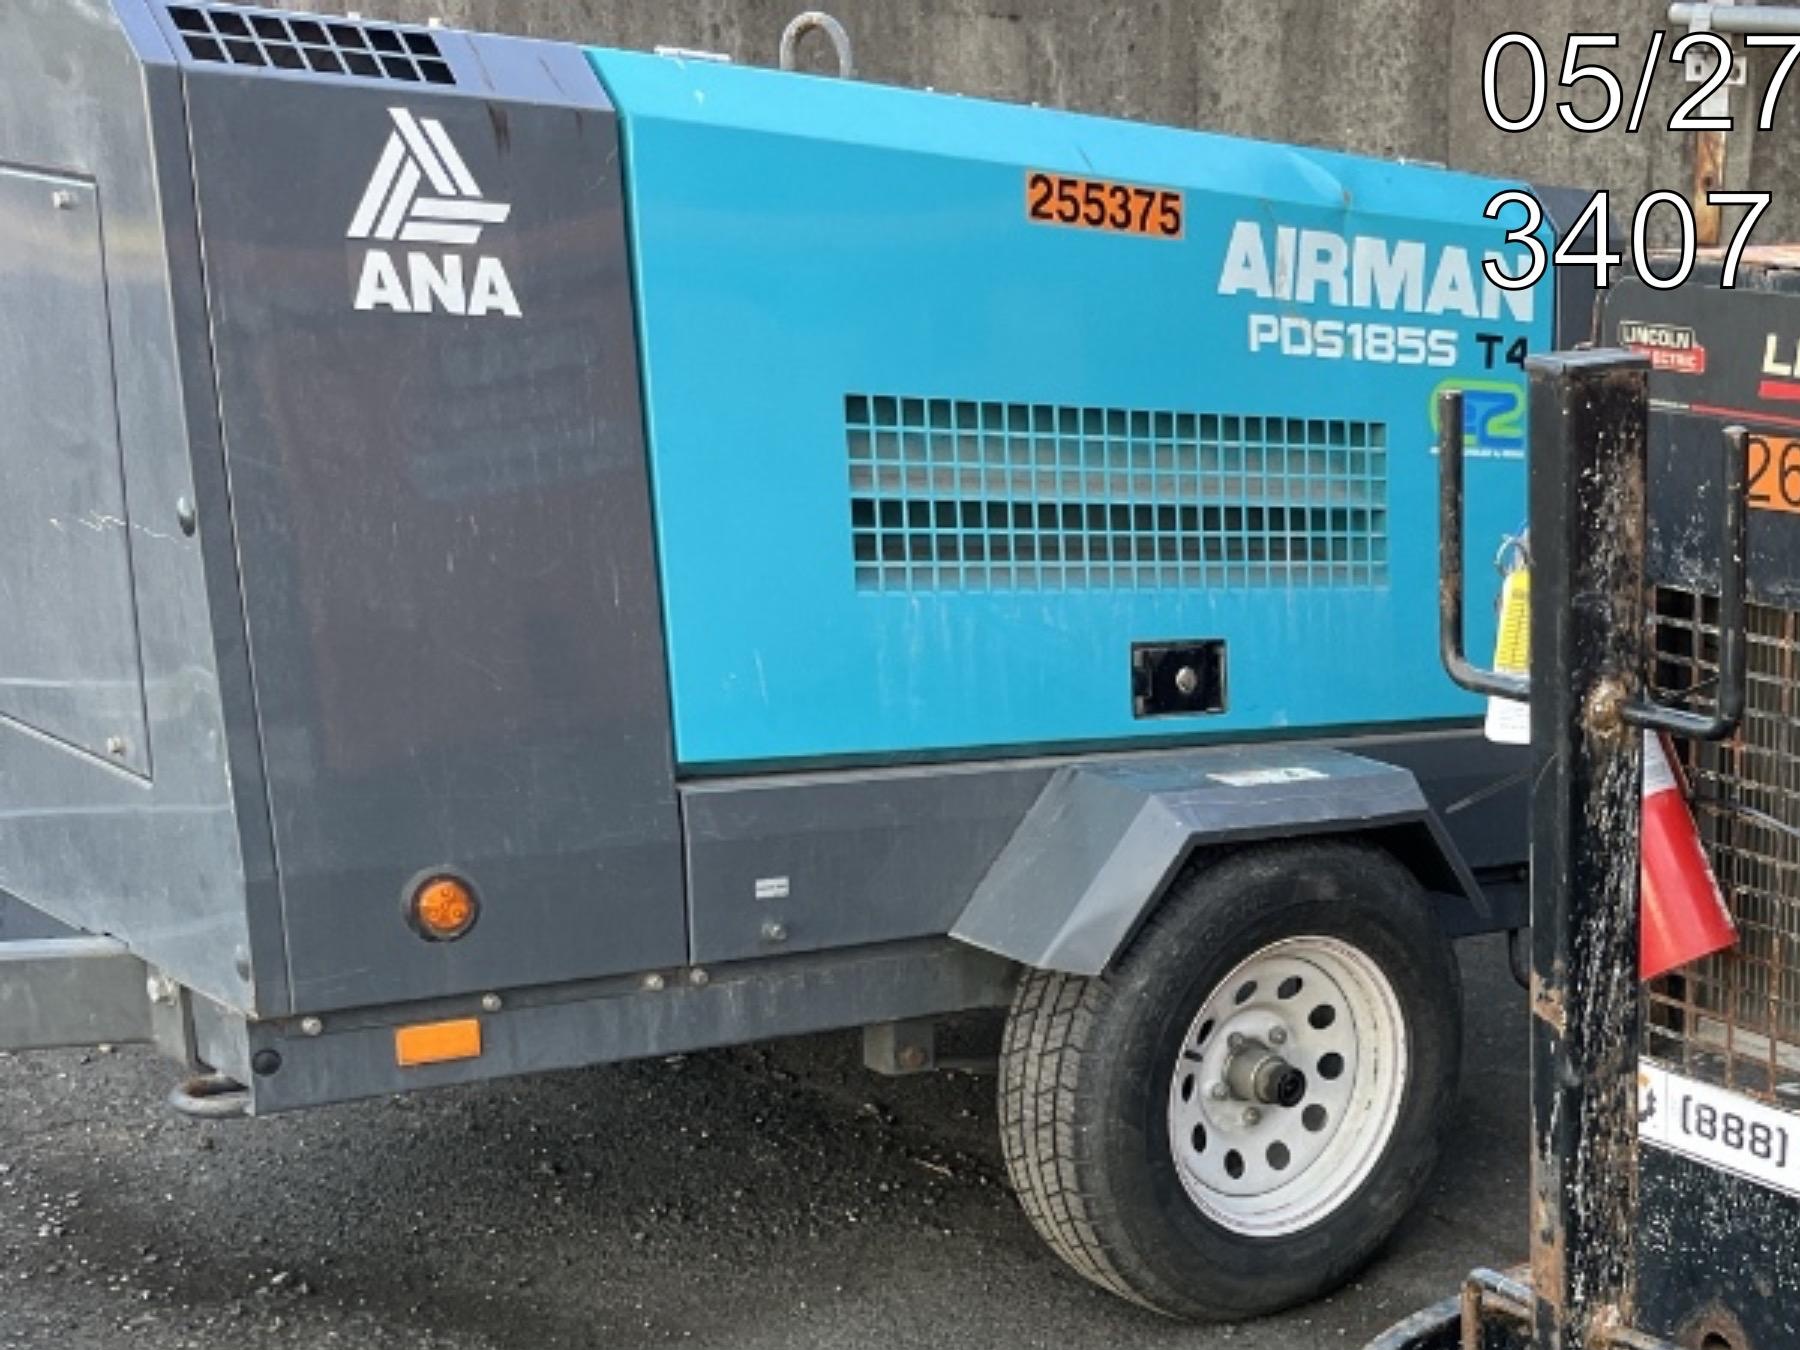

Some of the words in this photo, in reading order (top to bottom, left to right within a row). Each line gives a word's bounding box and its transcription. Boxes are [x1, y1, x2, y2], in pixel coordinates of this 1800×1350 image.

[1029, 174, 1181, 235] 255375
[354, 250, 522, 318] ANA
[1217, 221, 1534, 322] AIRMAN
[1249, 313, 1459, 367] PDS185S
[1475, 333, 1529, 370] T4
